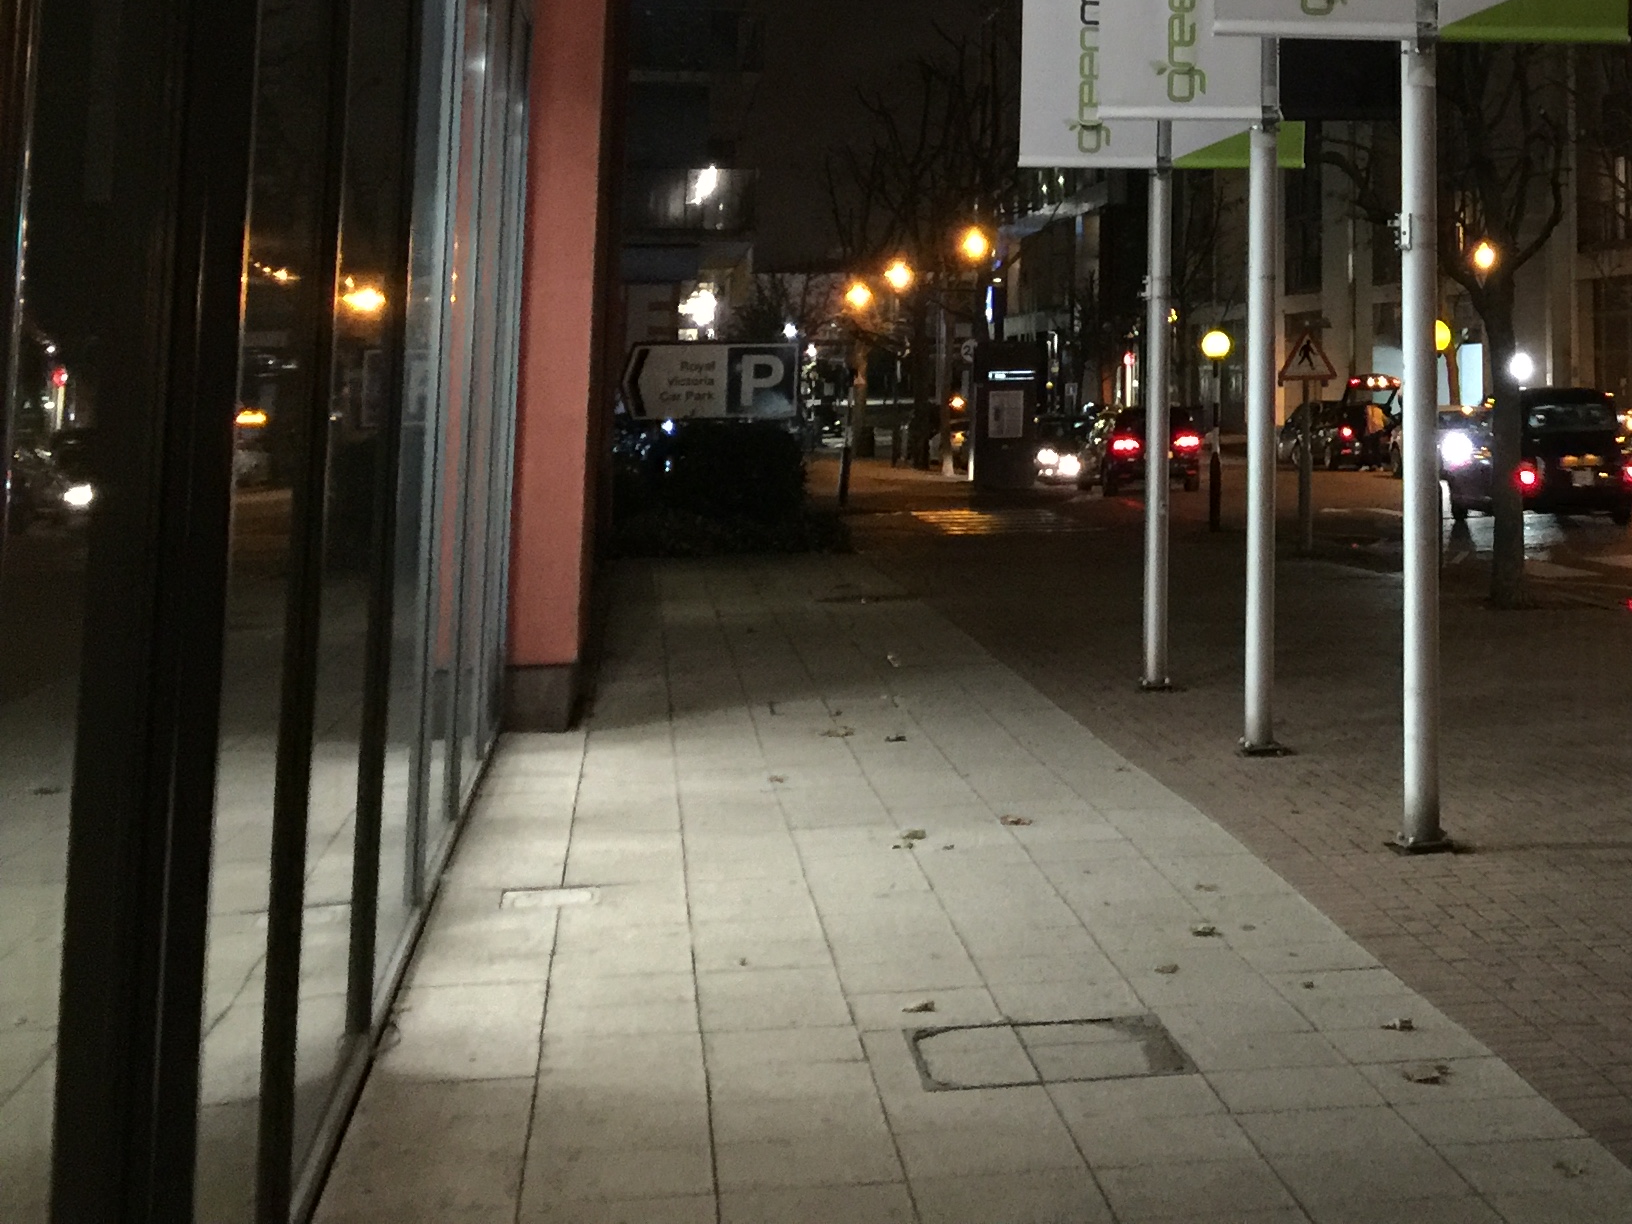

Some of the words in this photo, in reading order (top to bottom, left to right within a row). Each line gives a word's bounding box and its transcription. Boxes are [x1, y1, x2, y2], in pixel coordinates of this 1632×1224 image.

[680, 361, 716, 374] Royal
[740, 354, 785, 407] P
[659, 391, 681, 401] Car
[685, 390, 715, 401] Park
